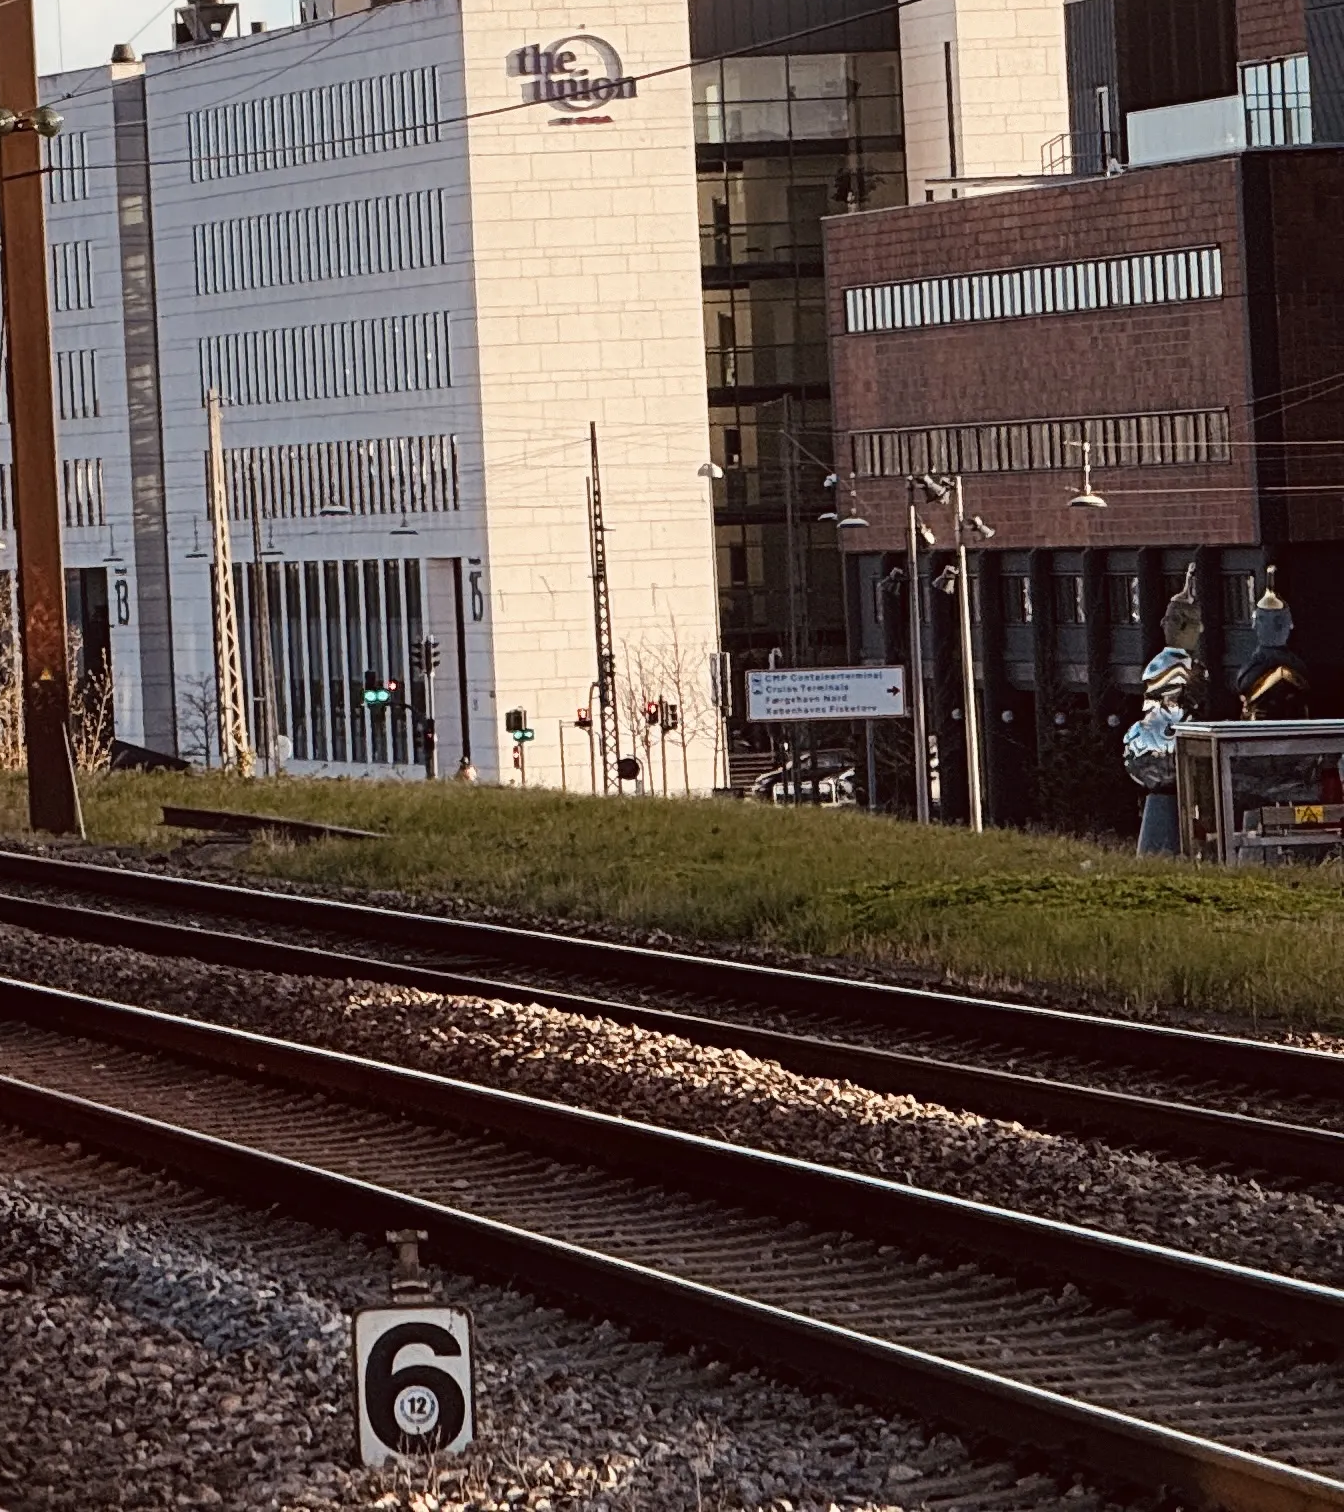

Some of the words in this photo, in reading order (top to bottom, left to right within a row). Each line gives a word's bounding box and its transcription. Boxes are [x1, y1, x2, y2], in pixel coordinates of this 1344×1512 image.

[505, 43, 577, 77] the
[365, 1321, 466, 1455] 6
[407, 1396, 427, 1415] 12
